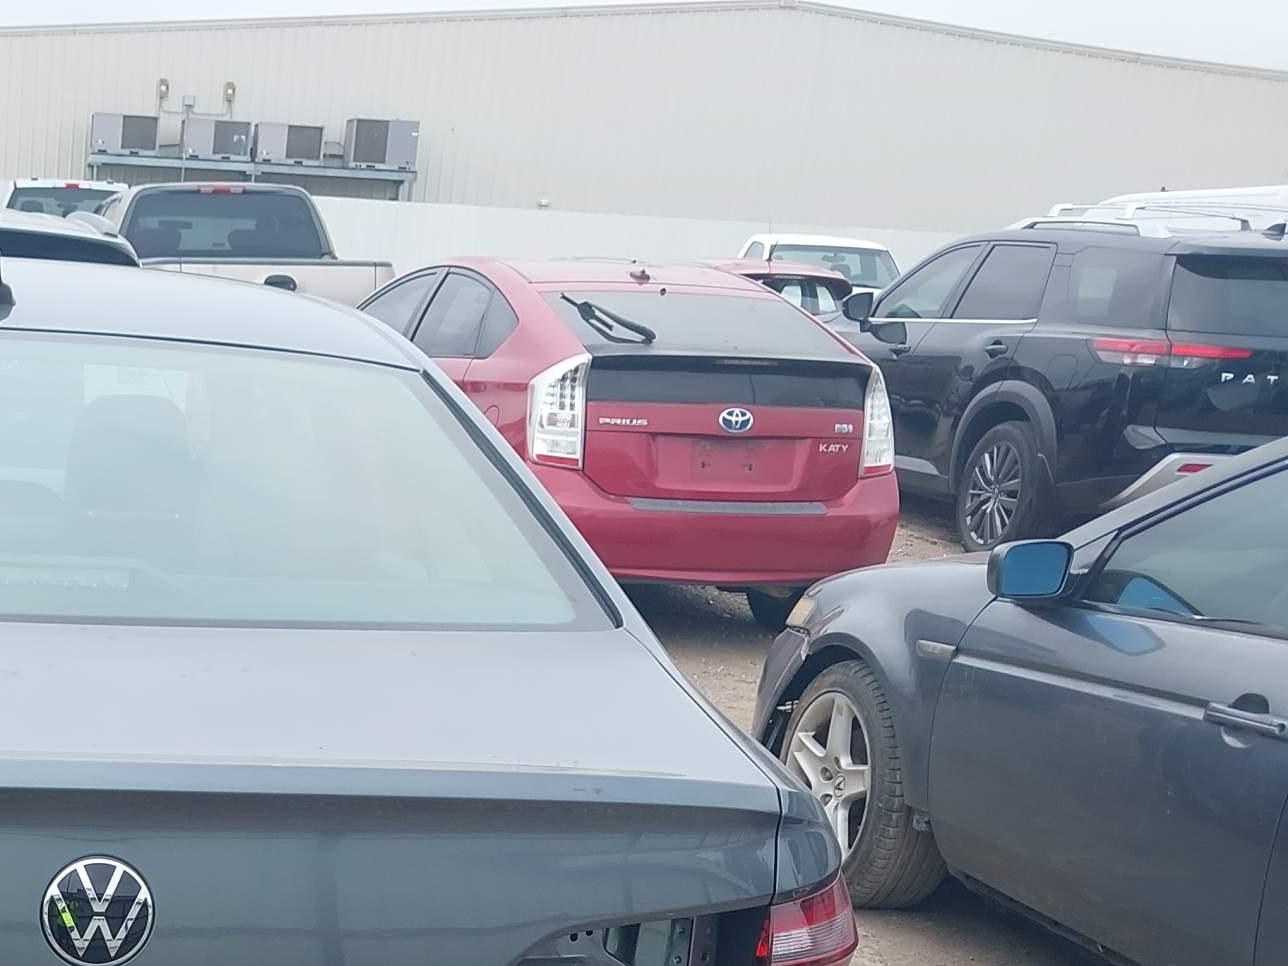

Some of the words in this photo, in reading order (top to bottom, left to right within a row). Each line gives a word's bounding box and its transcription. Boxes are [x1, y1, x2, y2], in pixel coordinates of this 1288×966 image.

[1221, 372, 1279, 385] PAT
[599, 417, 648, 426] PRIUS
[818, 443, 849, 453] KATY
